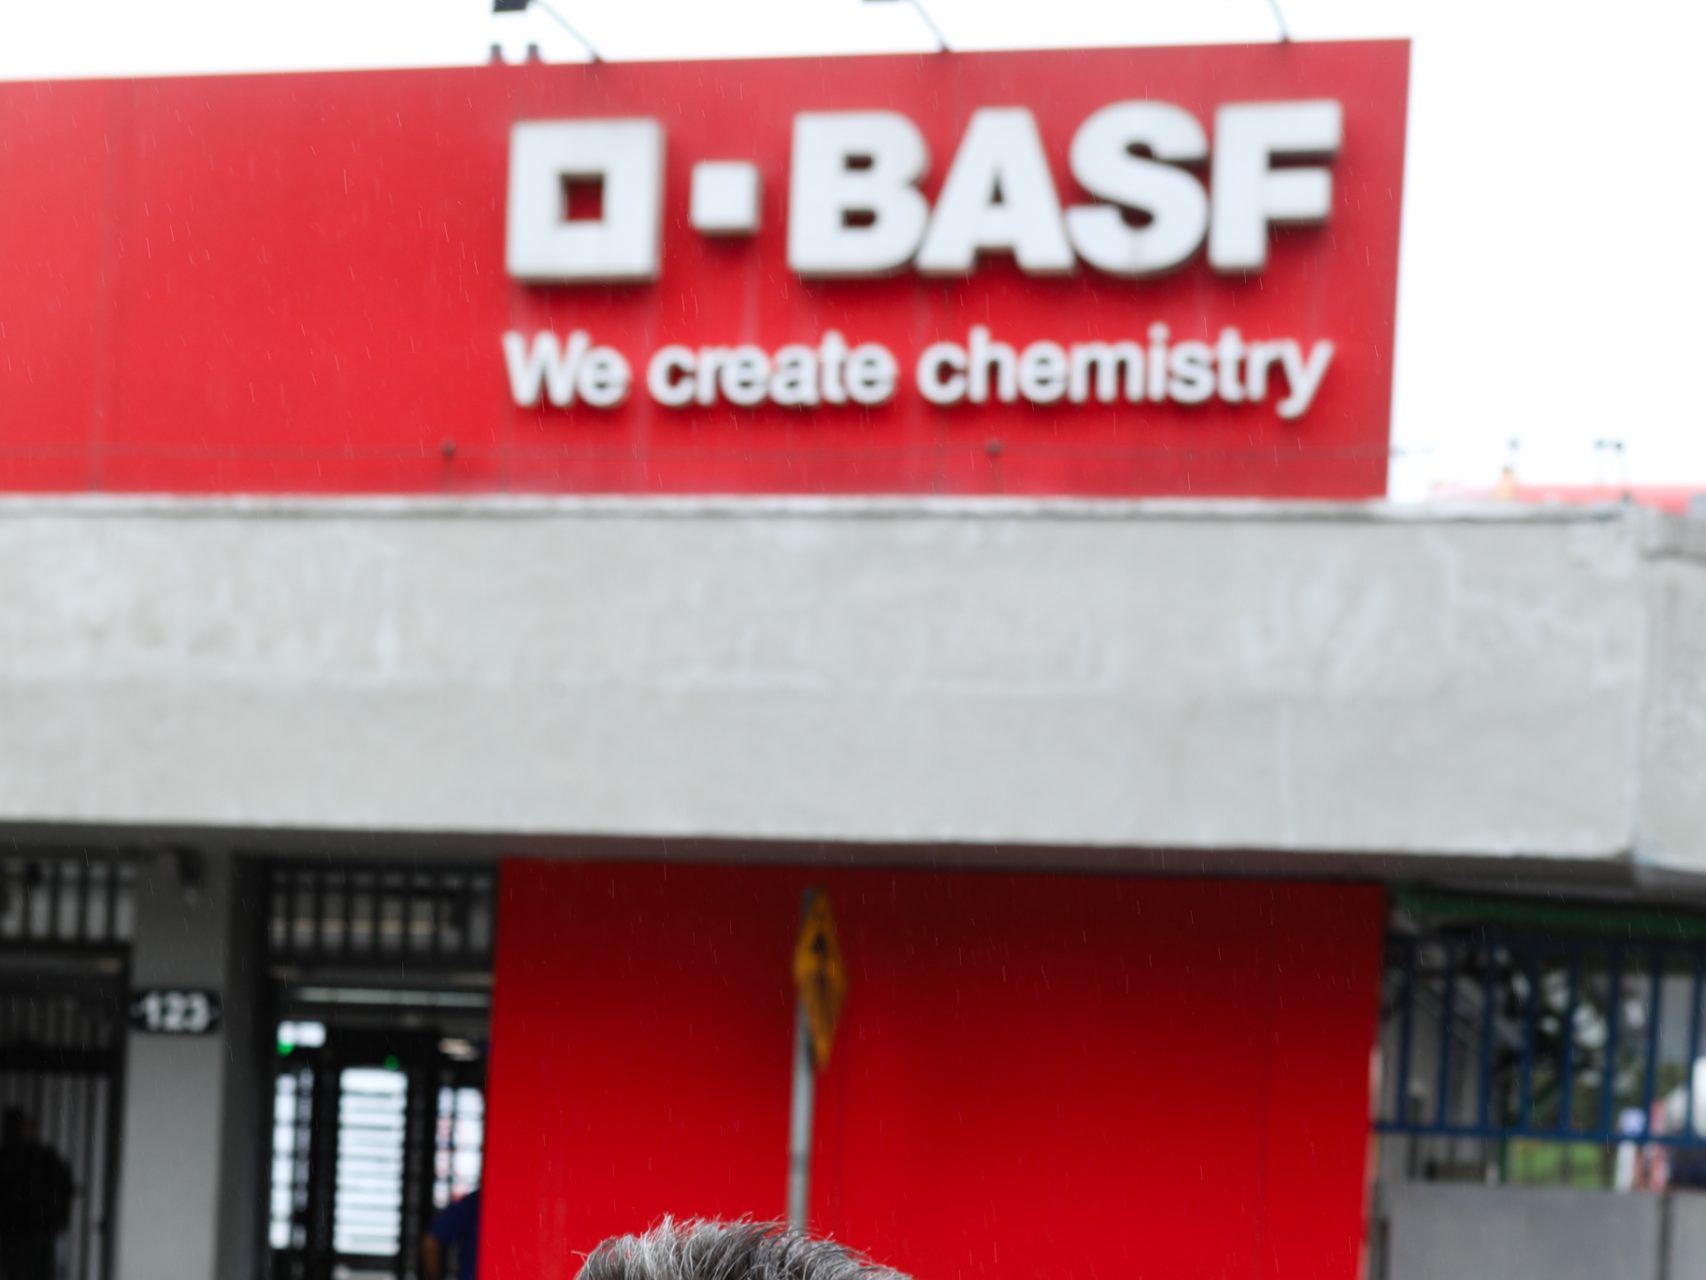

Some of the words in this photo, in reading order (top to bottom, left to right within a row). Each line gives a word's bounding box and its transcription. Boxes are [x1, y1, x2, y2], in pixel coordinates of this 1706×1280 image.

[787, 98, 1343, 275] BASF
[502, 330, 631, 406] We
[646, 330, 898, 406] create
[916, 322, 1335, 419] chemistry
[144, 990, 210, 1033] 123
